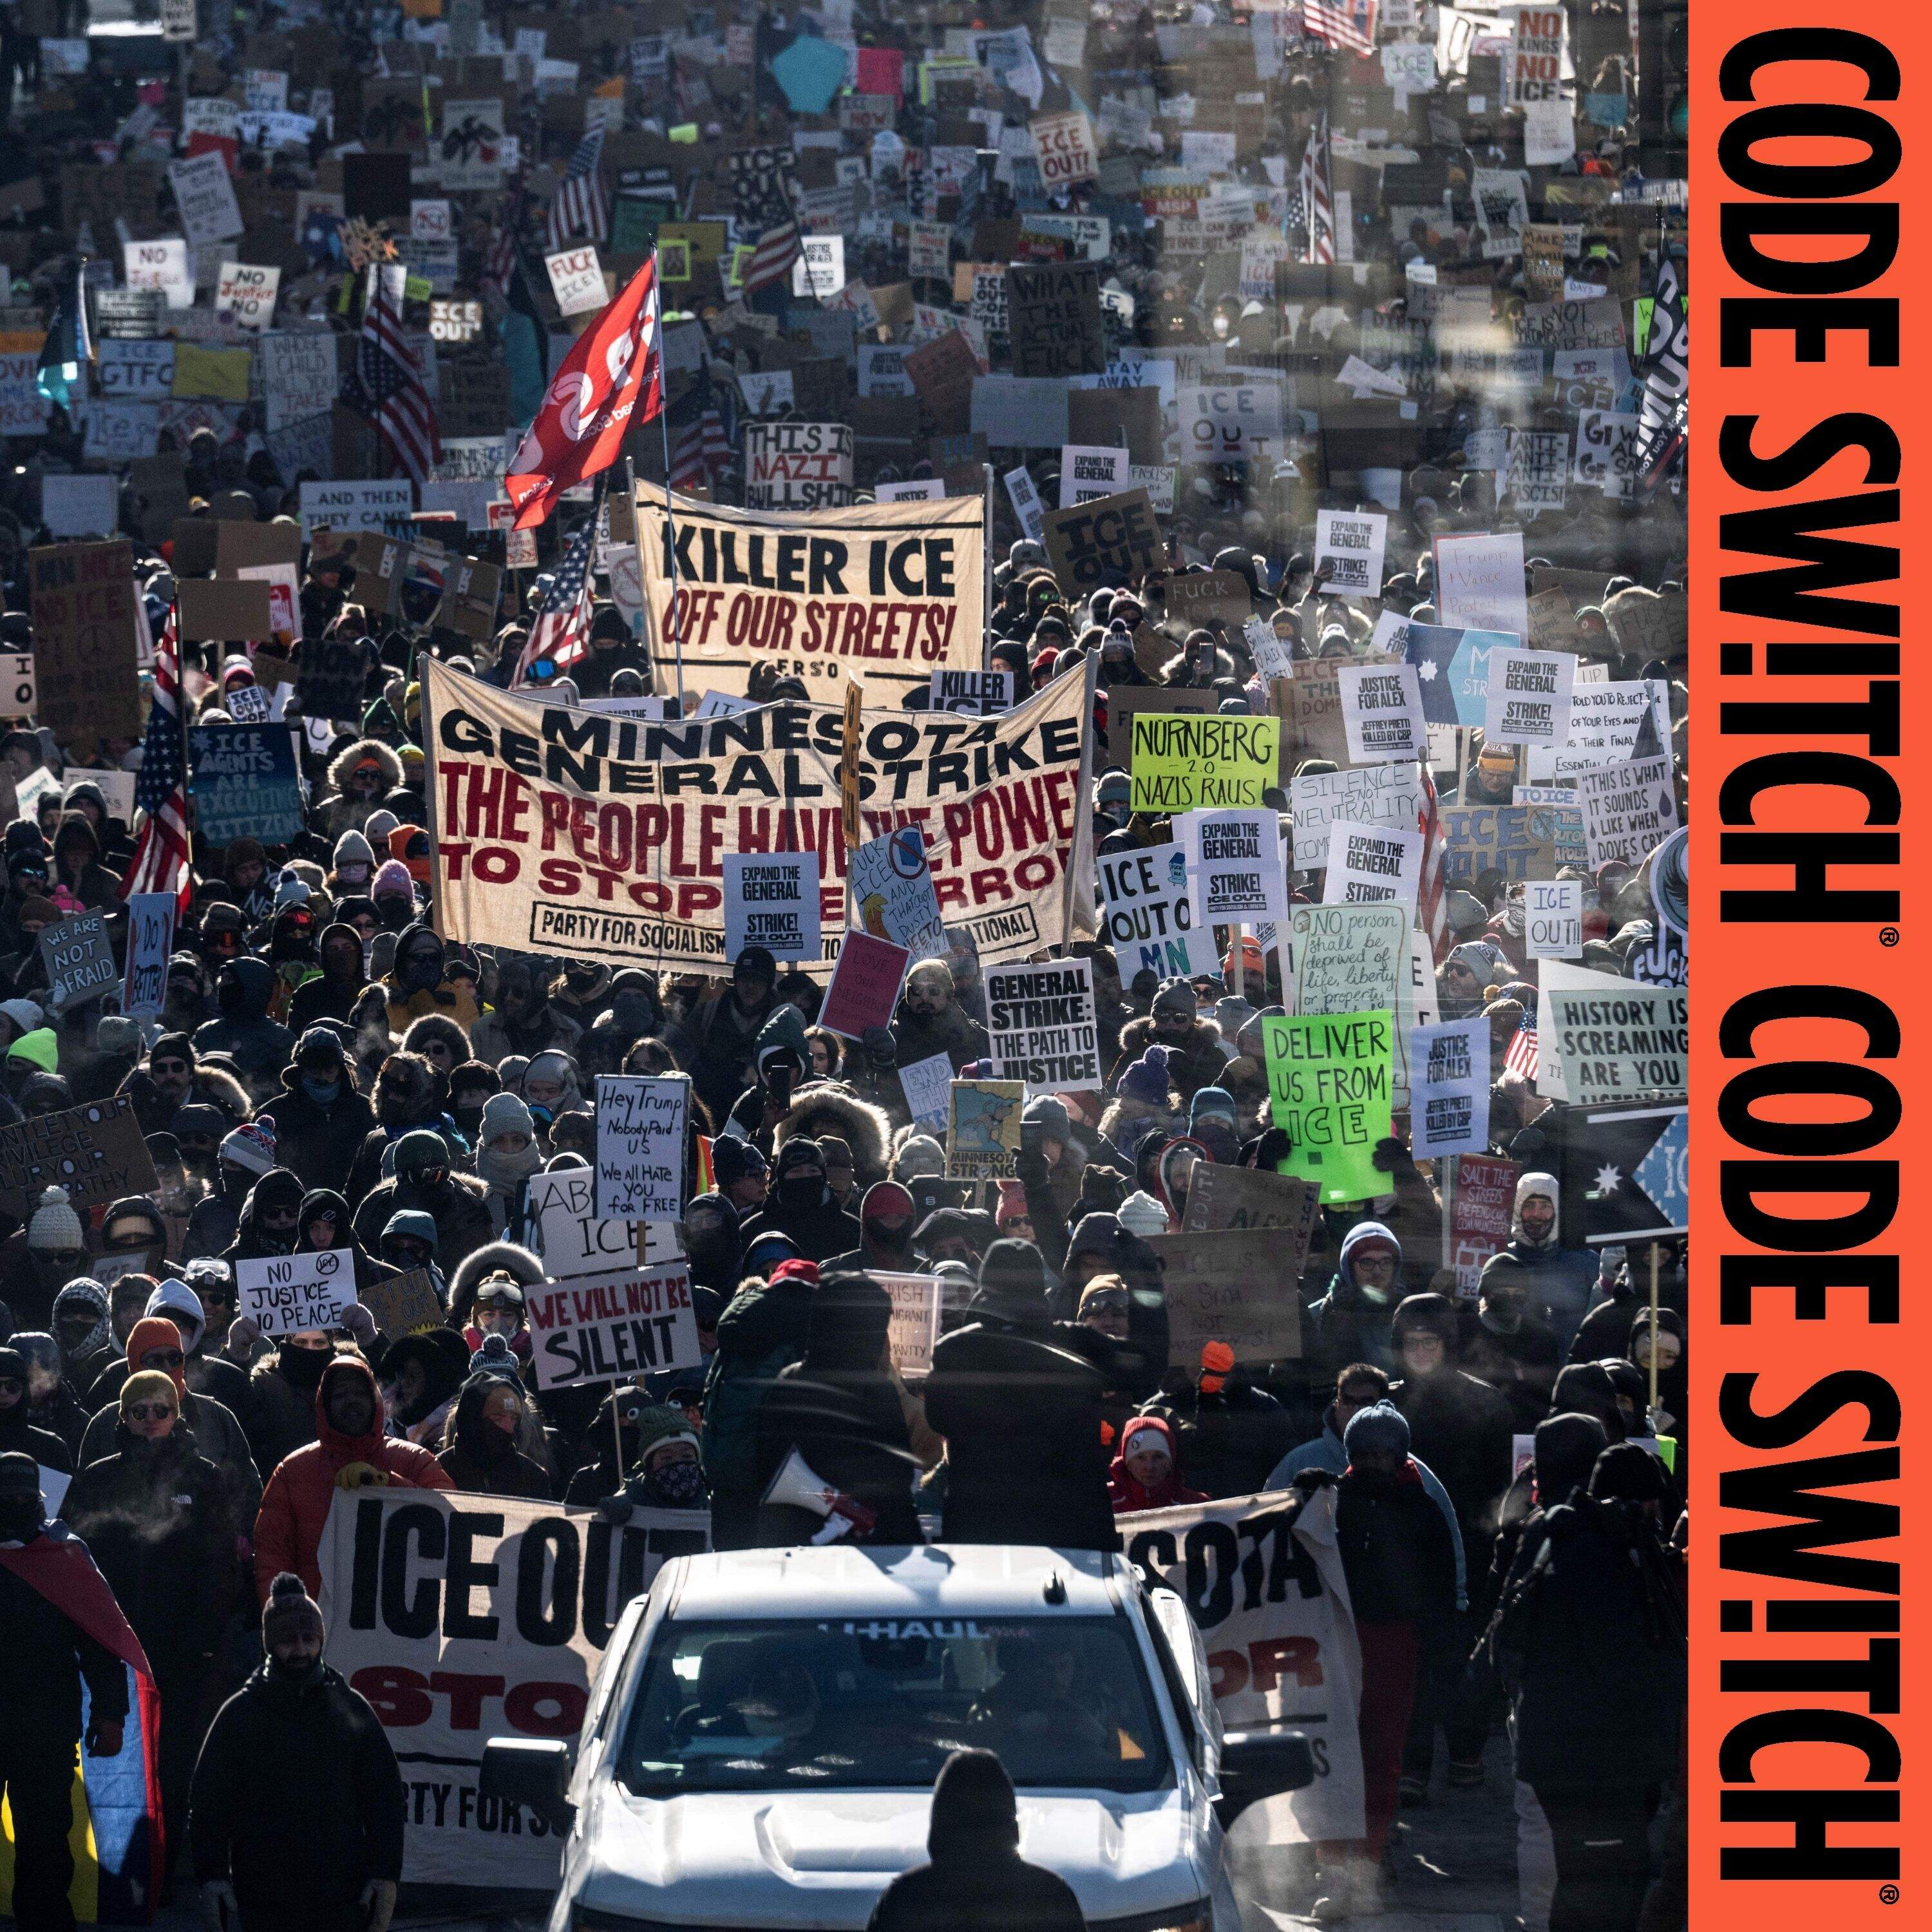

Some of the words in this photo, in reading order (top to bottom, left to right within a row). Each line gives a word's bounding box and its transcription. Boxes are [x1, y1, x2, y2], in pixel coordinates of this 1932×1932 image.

[1519, 10, 1560, 37] NO
[1518, 39, 1558, 52] KINGS
[1517, 54, 1558, 80] NO
[1516, 81, 1556, 100] ICE
[1038, 128, 1083, 155] ICE
[140, 249, 166, 264] NO
[551, 252, 593, 278] FUCK
[237, 270, 265, 285] NO
[562, 271, 598, 298] ICE!
[1012, 270, 1093, 302] WHAT
[232, 299, 258, 314] NO
[432, 301, 477, 321] ICE
[119, 343, 160, 357] ICE
[277, 354, 327, 374] CHILD
[1097, 375, 1143, 388] AWAY
[1197, 390, 1255, 413] ICE
[750, 425, 822, 453] THIS
[828, 425, 853, 459] IS
[1193, 419, 1270, 454] OUT
[753, 453, 838, 482] NAZI
[1074, 467, 1115, 481] GENERAL
[1075, 455, 1102, 467] EXPAND
[1103, 457, 1116, 468] THE
[319, 491, 354, 506] AND
[362, 489, 408, 504] THEN
[894, 489, 929, 502] JUSTICE
[1057, 502, 1148, 560] ICE
[1329, 533, 1371, 549] GENERAL
[1331, 520, 1359, 533] EXPAND
[1359, 523, 1373, 535] THE
[661, 521, 849, 596] KILLER
[869, 537, 955, 598] ICE
[1174, 581, 1229, 601] FUCK
[661, 589, 725, 645] OFF
[726, 592, 797, 650] OUR
[800, 600, 958, 662] STREETS!
[1508, 660, 1540, 674] EXPAND
[1542, 663, 1558, 676] THE
[231, 690, 260, 704] ICE
[940, 672, 1005, 699] KILLER
[1359, 676, 1402, 693] JUSTICE
[1506, 674, 1556, 693] GENERAL
[1358, 694, 1379, 710] FOR
[1381, 690, 1406, 708] ALEX
[1507, 701, 1551, 720] STRIKE!
[216, 733, 265, 752] ICE
[542, 708, 997, 762] MINNESOTA
[1135, 719, 1272, 765] NÜRNBERG
[198, 751, 275, 773] AGENTS
[439, 708, 823, 797] GENERAL
[833, 716, 1081, 802] STRIKE
[1300, 764, 1411, 799] SILENCE
[1622, 770, 1631, 784] IS
[1634, 762, 1667, 784] WHAT
[1135, 774, 1193, 806] NAZIS
[1201, 777, 1267, 806] RAUS!
[439, 761, 531, 843] THE
[540, 790, 728, 878] PEOPLE
[943, 768, 1081, 867] POWE
[1293, 793, 1419, 830] NEUTRALITY
[1600, 819, 1625, 837] LIKE
[1626, 811, 1660, 835] WHEN
[1202, 823, 1240, 839] EXPAND
[1241, 822, 1260, 837] THE
[1446, 806, 1531, 848] ICE
[1203, 838, 1262, 860] GENERAL
[1349, 835, 1385, 855] EXPAND
[1387, 842, 1404, 858] THE
[1597, 837, 1633, 862] DOVES
[742, 866, 781, 882] EXPAND
[782, 865, 801, 880] THE
[1347, 849, 1402, 878] GENERAL
[439, 842, 521, 885] TO
[538, 858, 723, 920] STOP
[743, 881, 802, 902] GENERAL
[1104, 855, 1160, 902] ICE
[1210, 873, 1261, 895] STRIKE!
[1533, 887, 1571, 911] ICE
[46, 930, 70, 947] WE
[73, 917, 100, 935] ARE
[143, 916, 159, 950] DO
[542, 909, 600, 943] PARTY
[601, 919, 637, 949] FOR
[638, 924, 726, 956] SOCIALISM
[747, 913, 799, 934] STRIKE!
[1111, 901, 1168, 942] OUT
[1175, 897, 1190, 931] O
[1312, 909, 1343, 936] NO
[1348, 914, 1399, 934] person
[53, 937, 97, 968] NOT
[1311, 933, 1355, 954] shall
[1363, 931, 1386, 950] be
[1139, 937, 1192, 979] MN
[53, 957, 114, 996] AFRAID
[989, 969, 1090, 1001] GENERAL
[990, 996, 1092, 1030] STRIKE:
[1304, 992, 1318, 1007] or
[1323, 989, 1385, 1012] property
[1564, 999, 1657, 1027] HISTORY
[1667, 998, 1689, 1025] IS
[992, 1033, 1025, 1058] THE
[1028, 1027, 1070, 1056] PATH
[1073, 1025, 1094, 1050] TO
[1273, 1020, 1389, 1061] DELIVER
[1428, 1034, 1470, 1061] JUSTICE
[1564, 1028, 1689, 1057] SCREAMING
[905, 1059, 952, 1094] END
[1002, 1052, 1098, 1084] JUSTICE
[1427, 1061, 1447, 1084] FOR
[1446, 1056, 1472, 1081] ALEX
[1580, 1061, 1622, 1087] ARE
[1633, 1059, 1681, 1086] YOU
[1277, 1070, 1304, 1103] US
[1317, 1063, 1386, 1103] FROM
[601, 1085, 634, 1124] Hey
[634, 1084, 683, 1121] Trump
[1289, 1104, 1368, 1146] ICE
[1460, 1164, 1489, 1186] SALT
[1493, 1167, 1514, 1188] THE
[643, 1198, 677, 1213] FREE
[579, 1216, 658, 1258] ICE
[267, 1262, 292, 1285] NO
[247, 1280, 332, 1309] JUSTICE
[528, 1293, 572, 1331] WE
[576, 1287, 625, 1324] WILL
[628, 1280, 663, 1318] NOT
[666, 1276, 692, 1310] BE
[281, 1301, 343, 1329] PEACE
[544, 1314, 677, 1385] SILENT
[348, 1498, 506, 1642] ICE
[348, 1665, 591, 1737] STO
